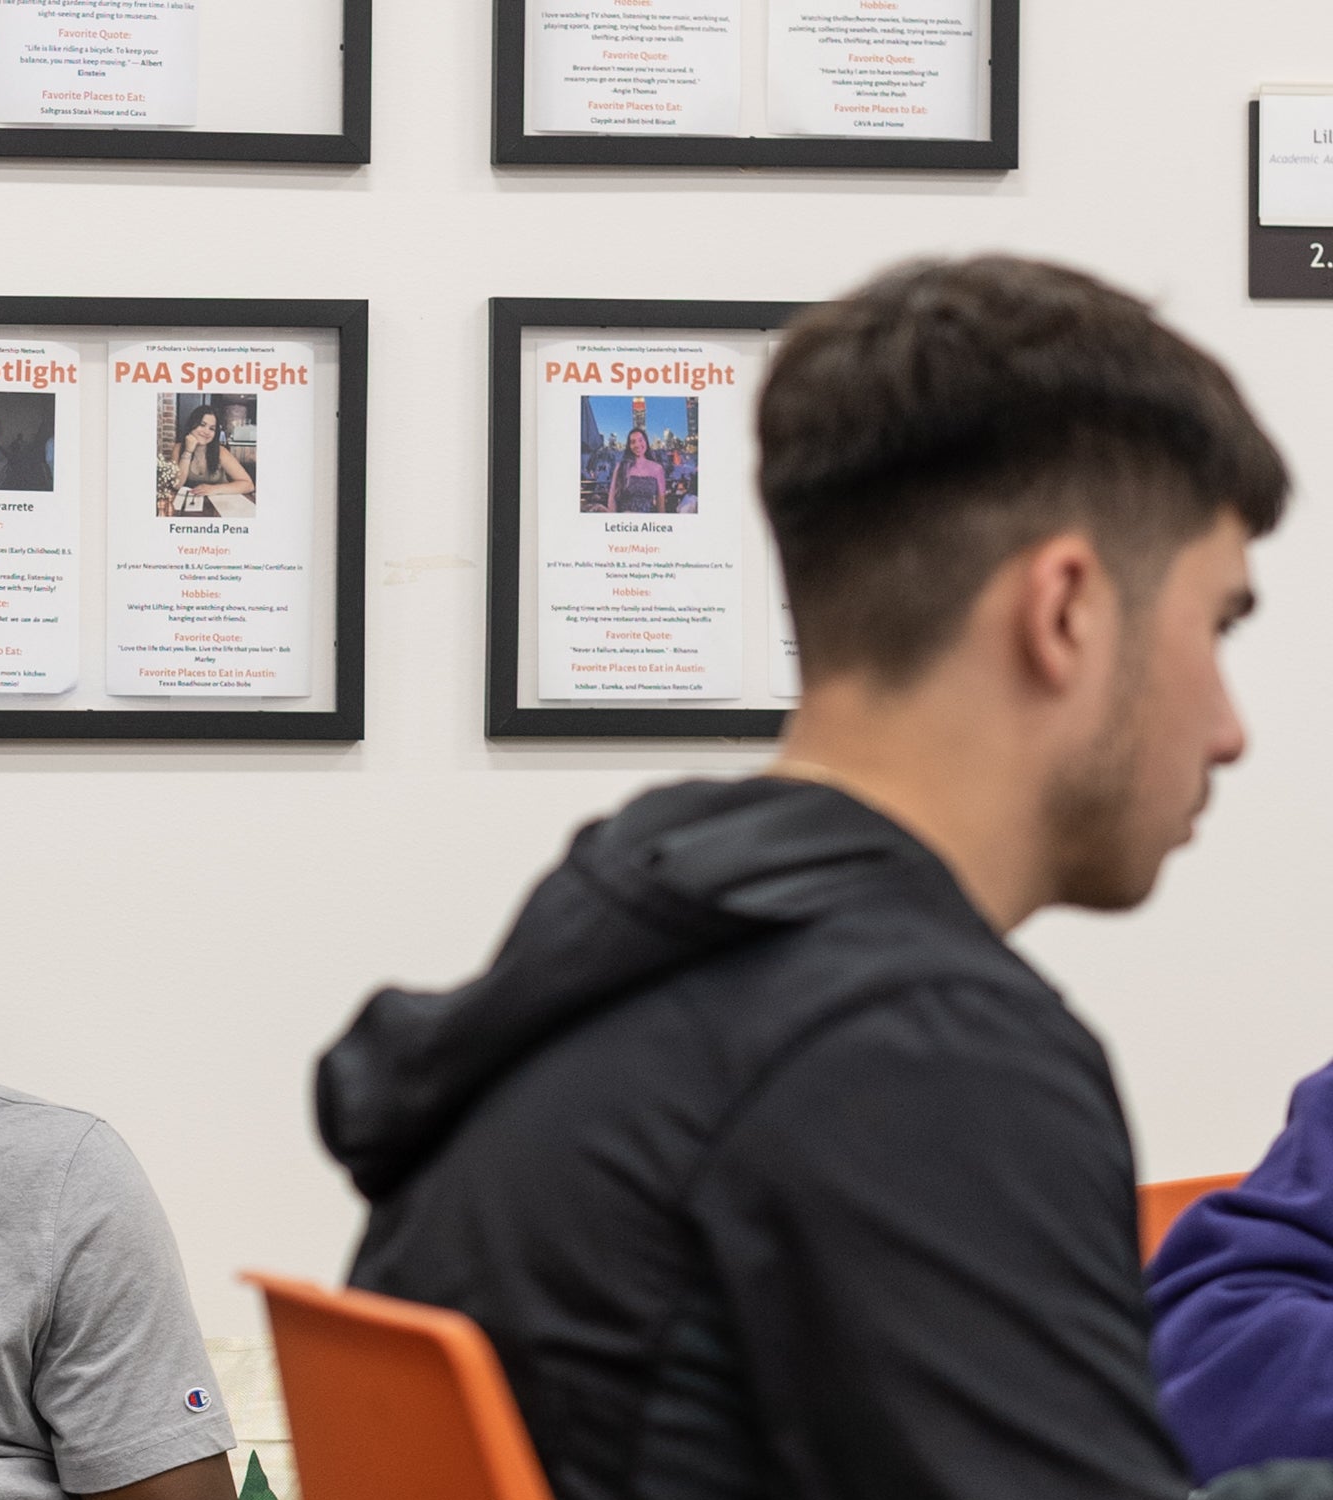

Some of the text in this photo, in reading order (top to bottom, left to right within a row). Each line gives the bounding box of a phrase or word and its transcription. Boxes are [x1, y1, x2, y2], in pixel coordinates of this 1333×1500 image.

[860, 1, 899, 10] Hobbies:
[59, 28, 132, 40] Favorite Quote:
[602, 51, 669, 61] Favorite Quote:
[849, 54, 915, 64] Favorite Quote:
[42, 90, 82, 100] Favorite
[83, 91, 113, 101] Places
[127, 93, 146, 102] Eat:
[588, 101, 625, 110] Favorite
[626, 102, 654, 111] Places
[666, 102, 682, 112] Eat:
[834, 104, 870, 113] Favorite
[872, 105, 899, 114] Places
[911, 106, 928, 114] Eat:
[1269, 154, 1319, 164] Academic
[115, 362, 308, 390] PAA Spotlight
[546, 362, 735, 390] PAA Spotlight
[170, 524, 249, 534] Fernanda Pena
[605, 522, 673, 532] Leticia Alicea
[177, 546, 231, 556] Year/Major:
[608, 544, 660, 554] Year/Major:
[182, 590, 221, 598] Hobbies:
[613, 588, 651, 596] Hobbies:
[175, 633, 243, 643] Favorite Quote:
[606, 631, 672, 641] Favorite Quote:
[6, 647, 22, 656] Eat:
[139, 668, 177, 677] Favorite
[178, 668, 206, 677] Places
[219, 669, 233, 678] Eat
[235, 669, 244, 677] in
[245, 669, 276, 678] Austin:
[571, 664, 608, 672] Favorite
[609, 664, 637, 672] Places
[649, 664, 664, 672] Eat
[665, 664, 674, 672] in
[675, 664, 705, 672] Austin:
